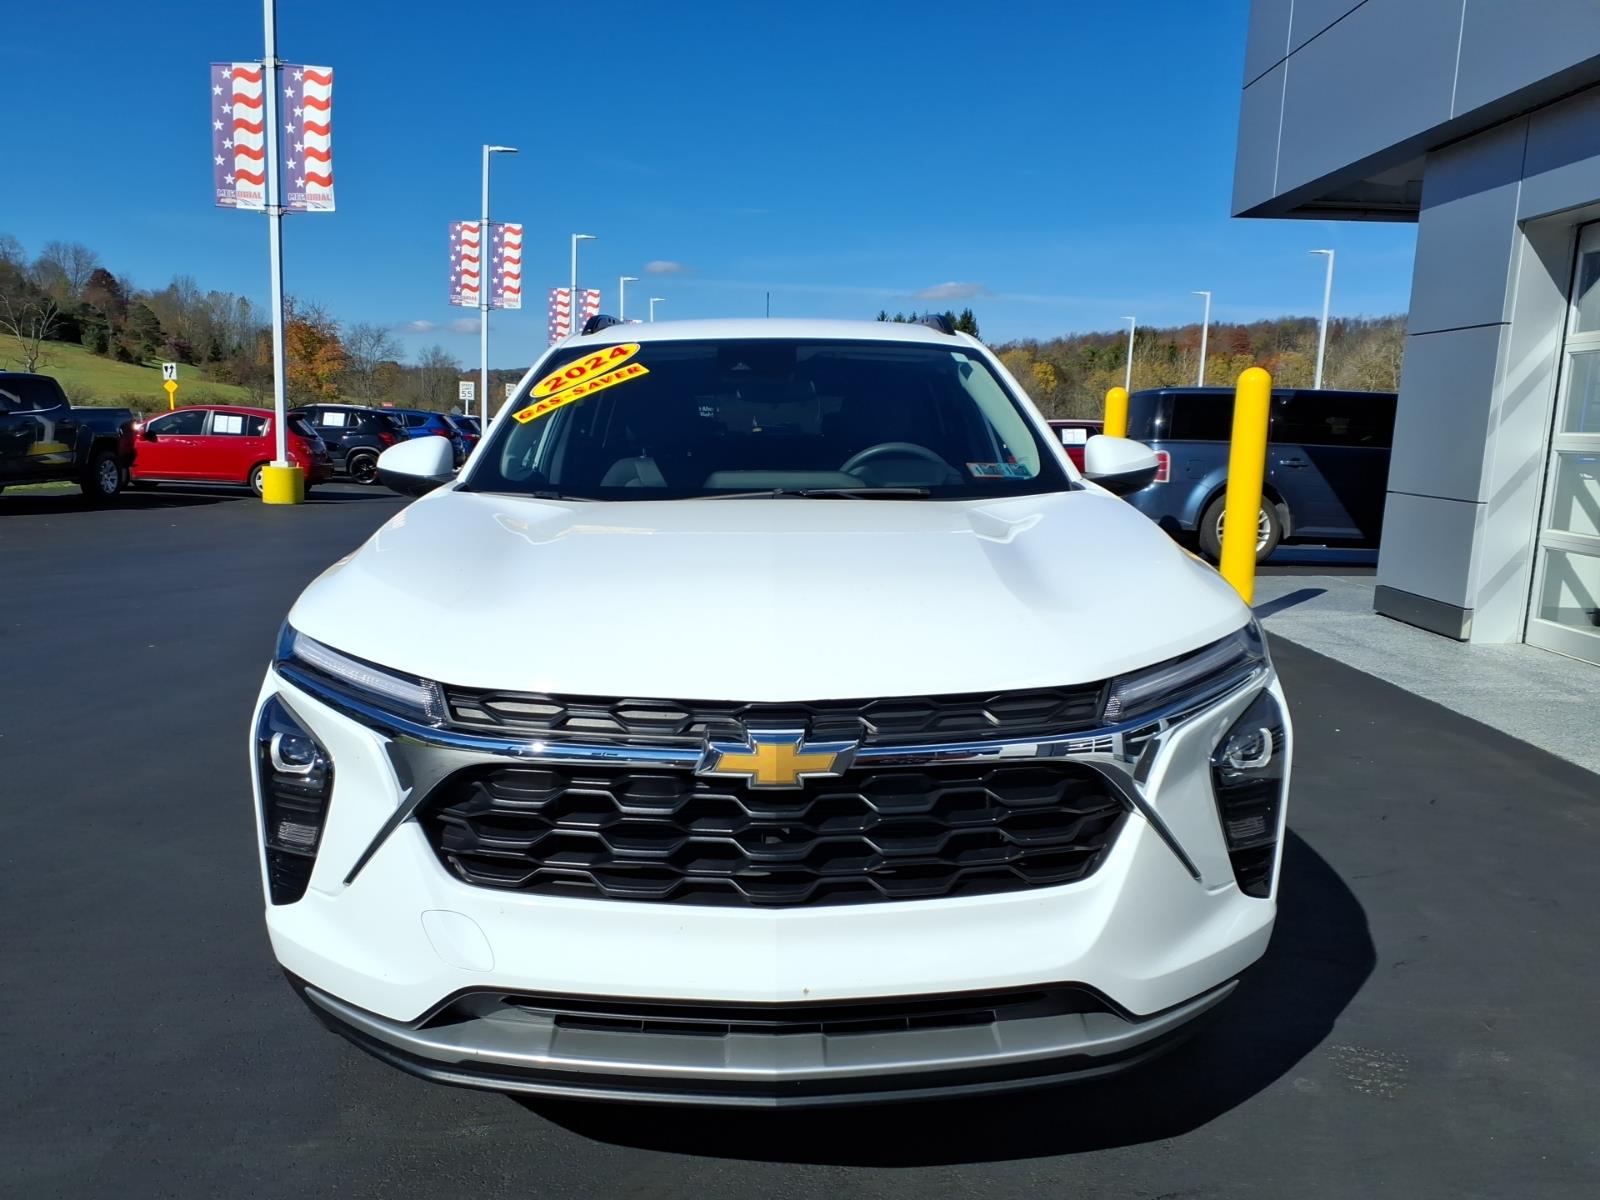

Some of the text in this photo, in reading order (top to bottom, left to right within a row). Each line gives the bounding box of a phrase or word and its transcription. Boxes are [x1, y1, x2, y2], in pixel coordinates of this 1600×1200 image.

[544, 346, 630, 392] 2024
[461, 390, 473, 398] 55
[518, 366, 642, 420] GAS-SAVER
